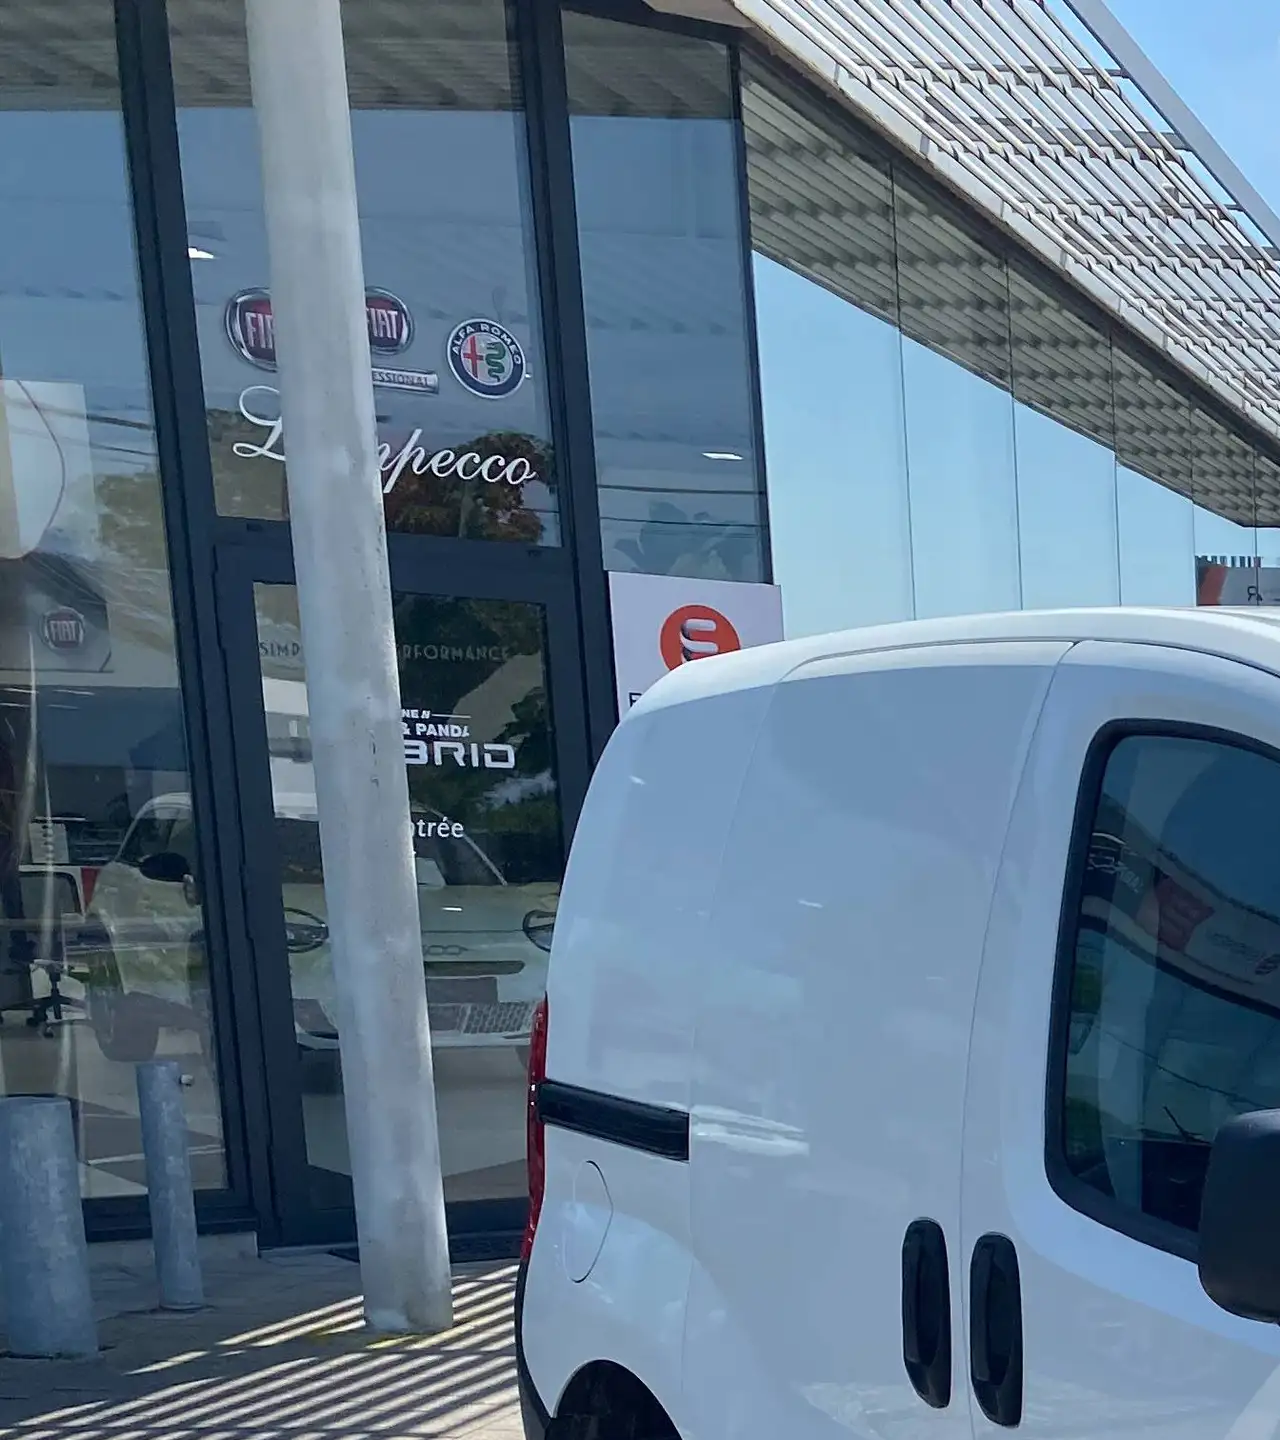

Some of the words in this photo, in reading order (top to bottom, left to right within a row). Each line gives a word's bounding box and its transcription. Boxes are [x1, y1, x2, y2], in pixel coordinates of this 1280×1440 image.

[452, 325, 475, 356] ALFA
[481, 323, 522, 365] ROMEO
[50, 620, 77, 641] FIAT
